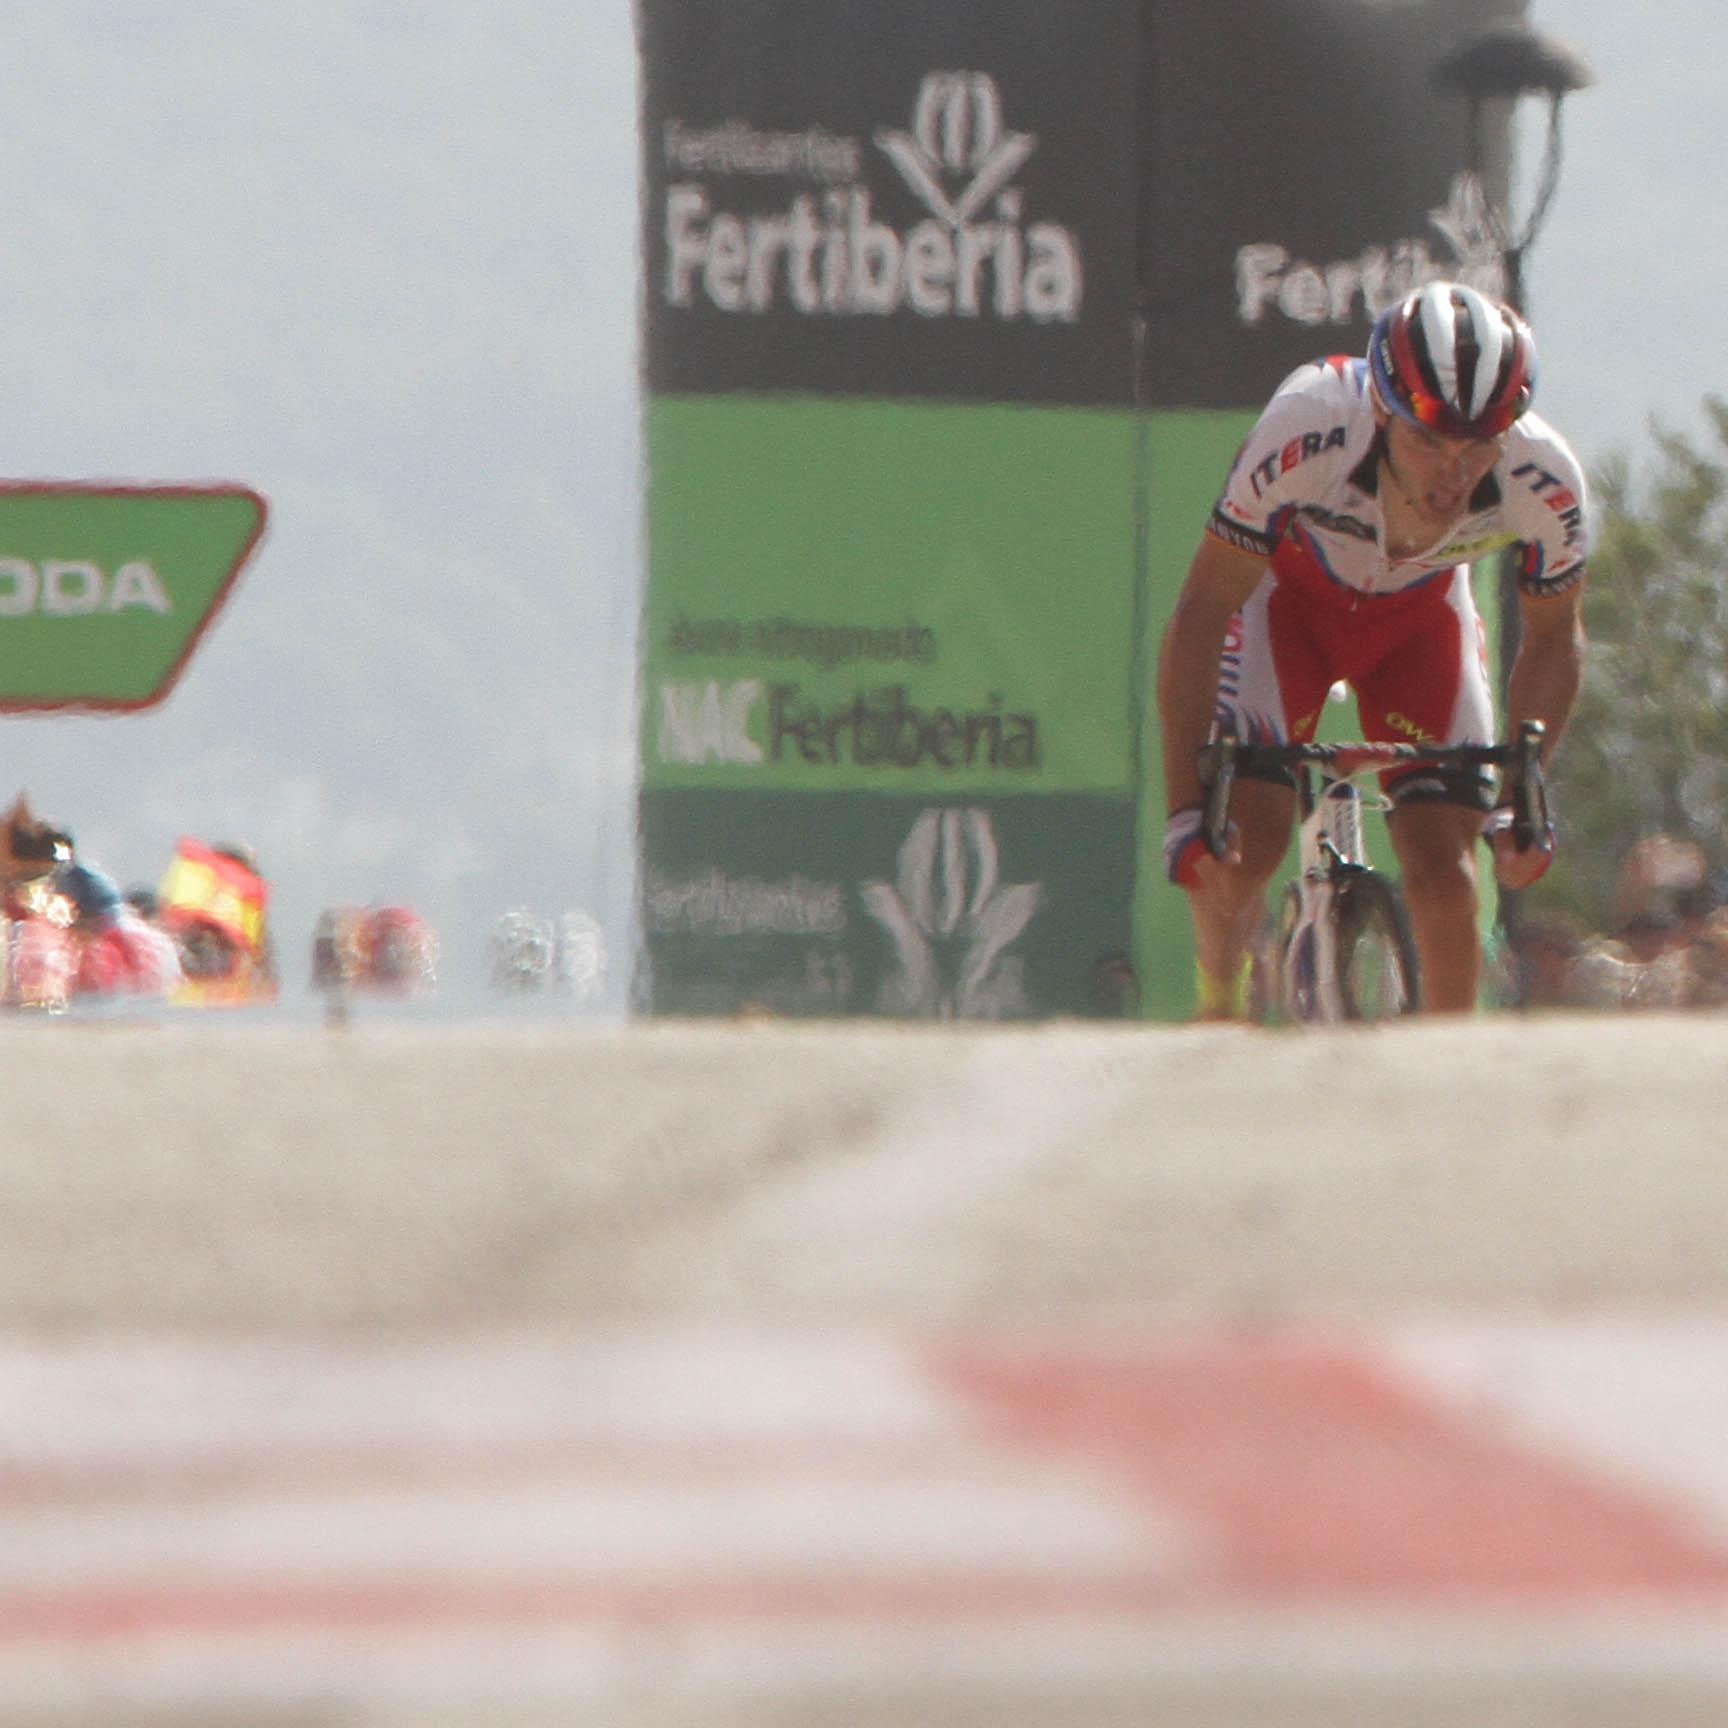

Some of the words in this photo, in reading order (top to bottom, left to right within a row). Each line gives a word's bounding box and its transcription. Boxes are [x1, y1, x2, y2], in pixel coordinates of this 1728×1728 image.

[664, 182, 1086, 325] Fertiberia
[1249, 425, 1347, 498] ITERA
[768, 682, 1043, 772] Fertiberia
